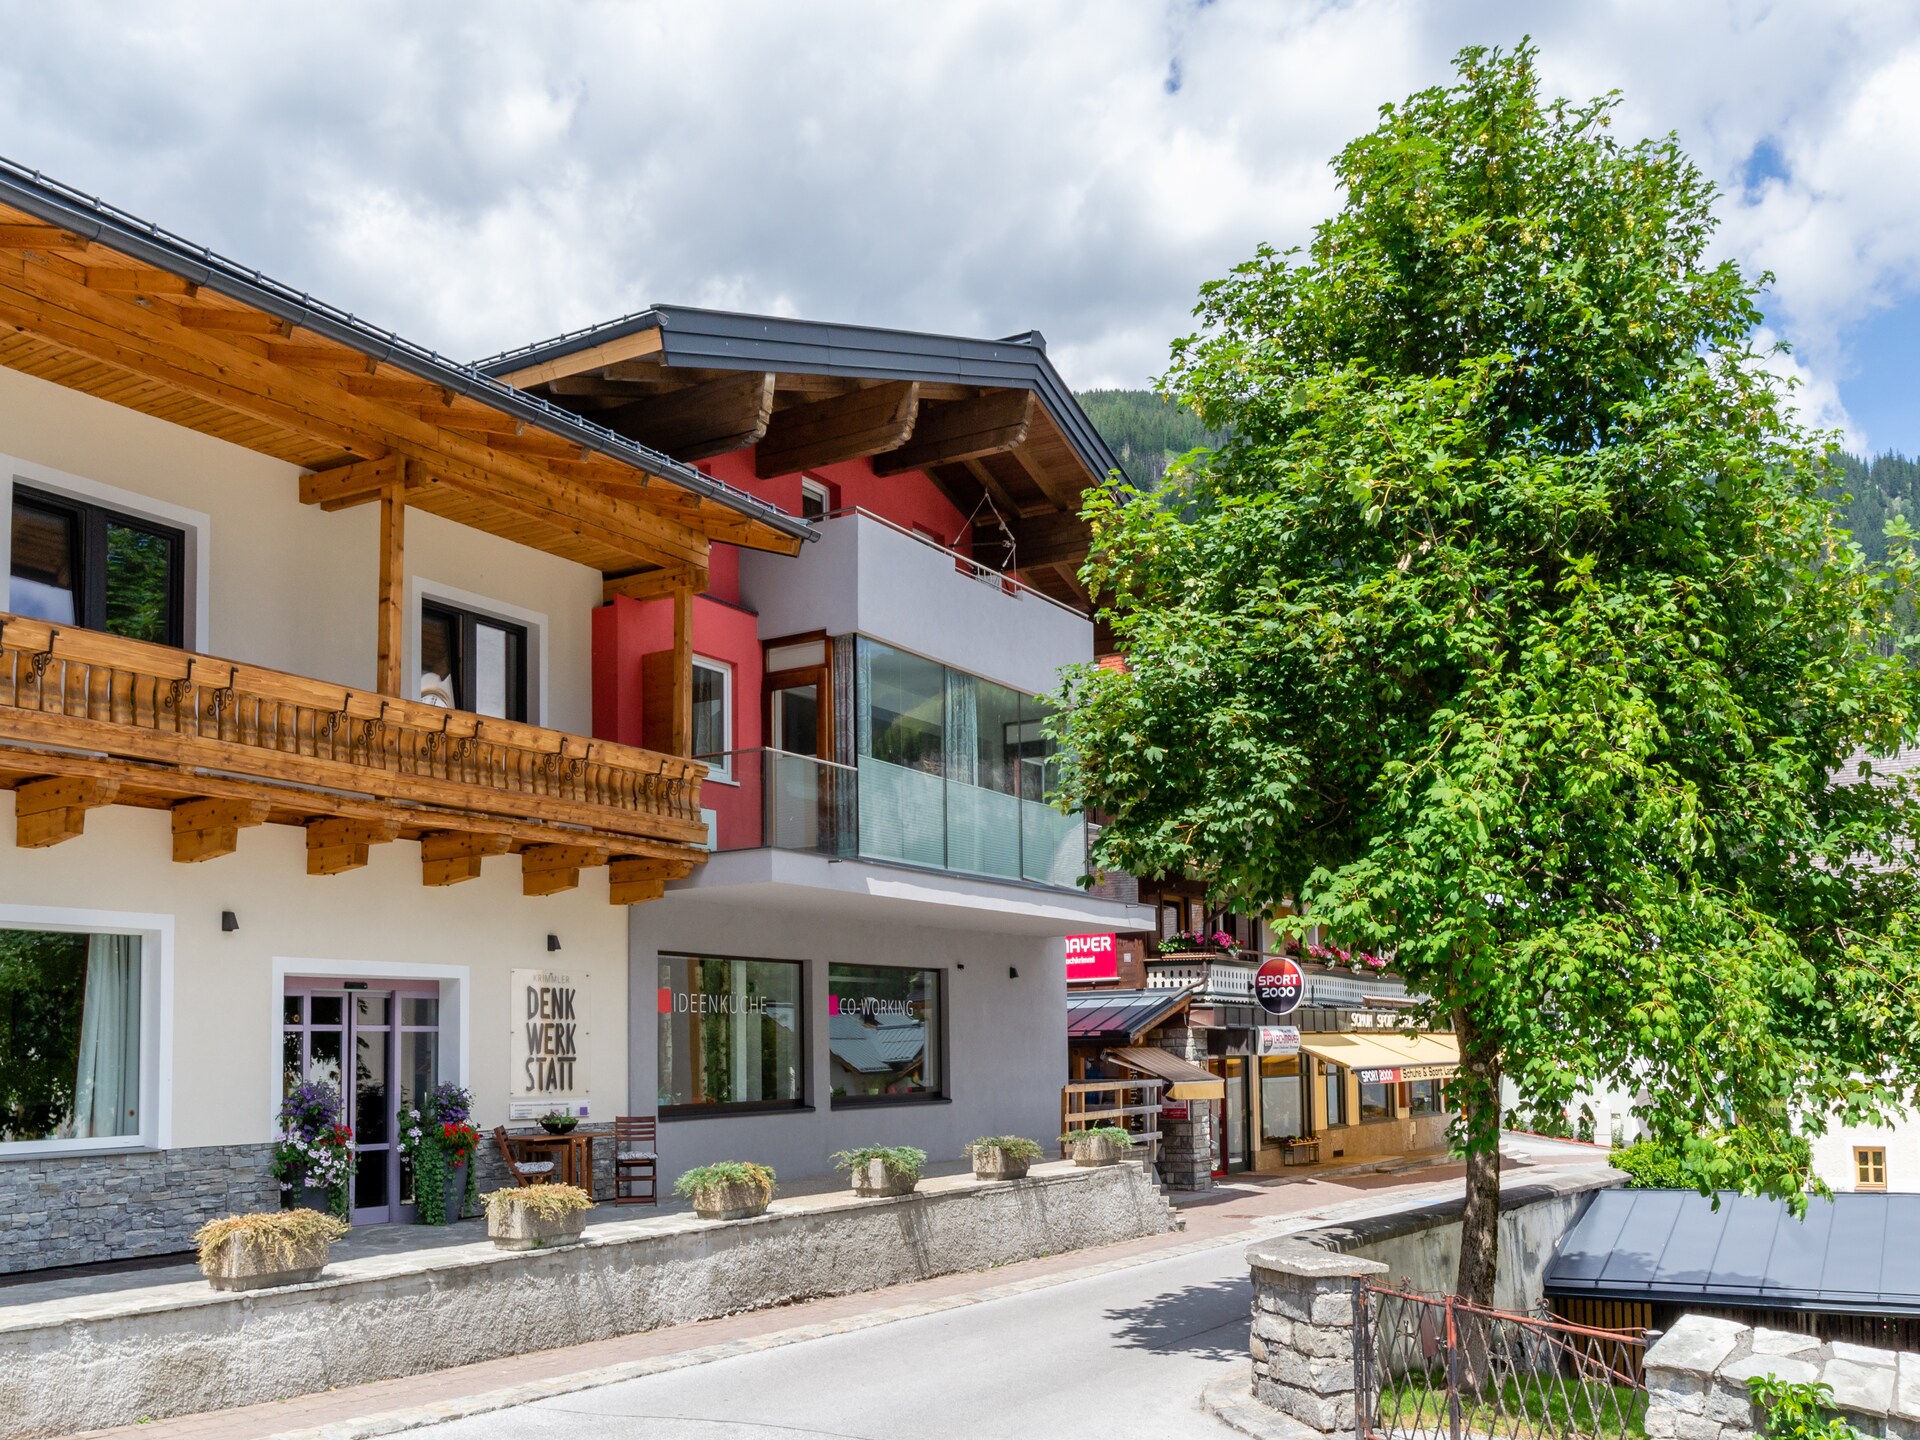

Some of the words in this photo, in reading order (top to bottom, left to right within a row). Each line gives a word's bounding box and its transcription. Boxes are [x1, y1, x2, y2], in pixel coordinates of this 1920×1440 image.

[533, 974, 570, 984] KRIMMLER
[1258, 974, 1299, 986] SPORT
[1261, 986, 1296, 998] 2000
[526, 985, 576, 1021] DENK
[673, 991, 767, 1015] IDEENKÜCHE
[839, 997, 914, 1017] CO-WORKING
[1351, 1012, 1373, 1028] SCHUH
[525, 1022, 577, 1056] WERK
[525, 1056, 577, 1092] STATT
[1361, 1069, 1379, 1083] SPORT
[1379, 1068, 1394, 1081] 2000
[1402, 1067, 1422, 1079] Schuhe
[1422, 1066, 1427, 1077] &
[1428, 1066, 1443, 1078] Sport
